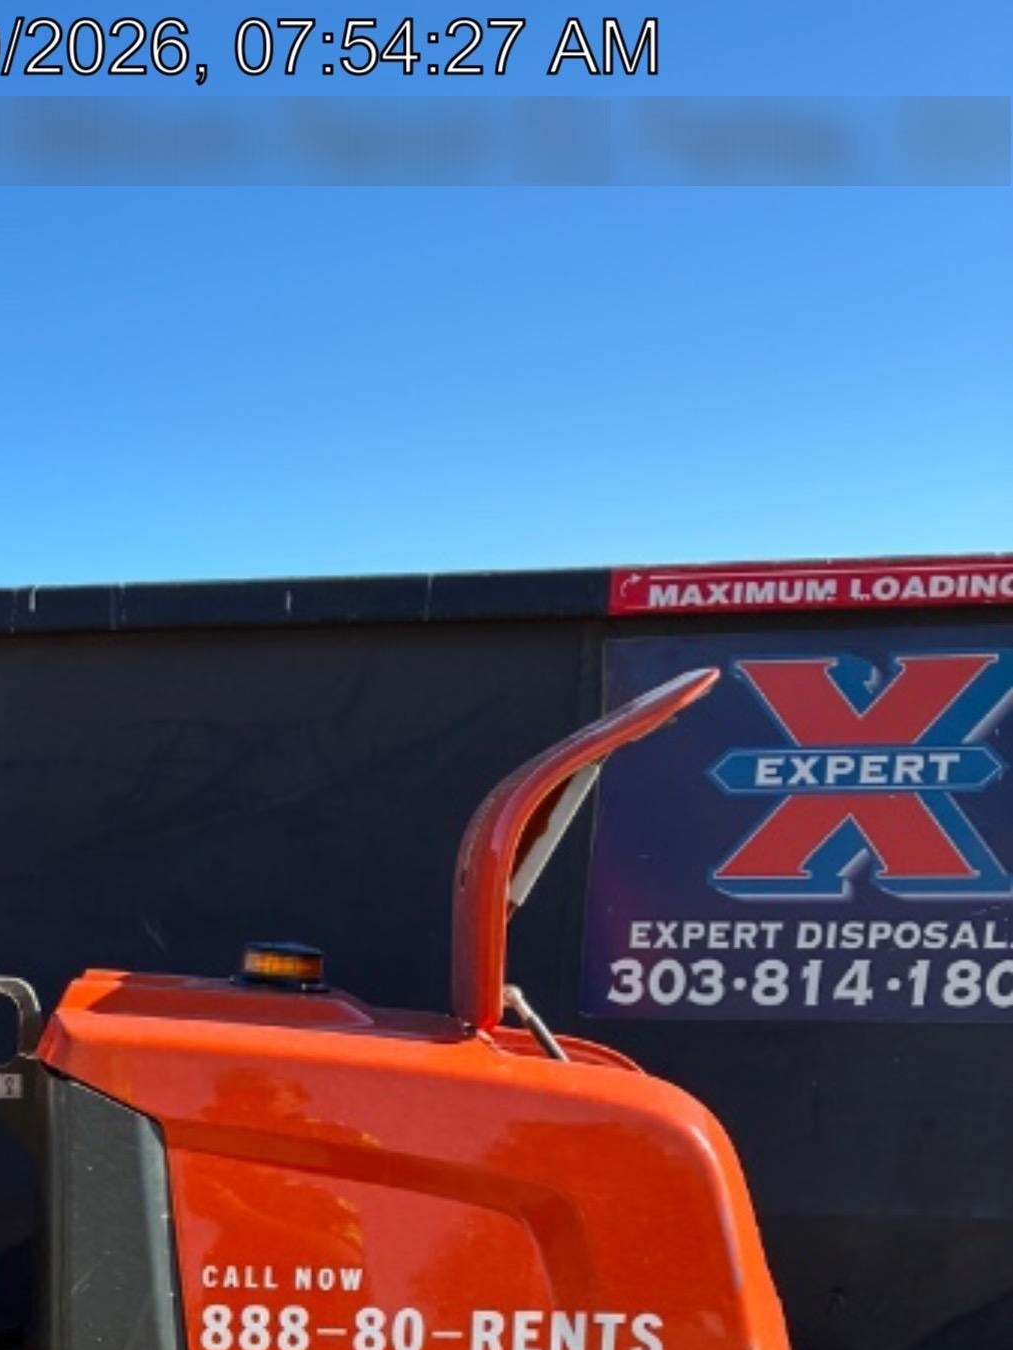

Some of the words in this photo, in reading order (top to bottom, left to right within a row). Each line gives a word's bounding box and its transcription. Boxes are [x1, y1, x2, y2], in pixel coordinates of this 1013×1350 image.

[648, 579, 837, 608] MAXIMUM
[755, 753, 960, 786] EXPERT
[628, 920, 784, 950] EXPERT
[201, 1265, 278, 1289] CALL
[294, 1267, 363, 1291] NOW
